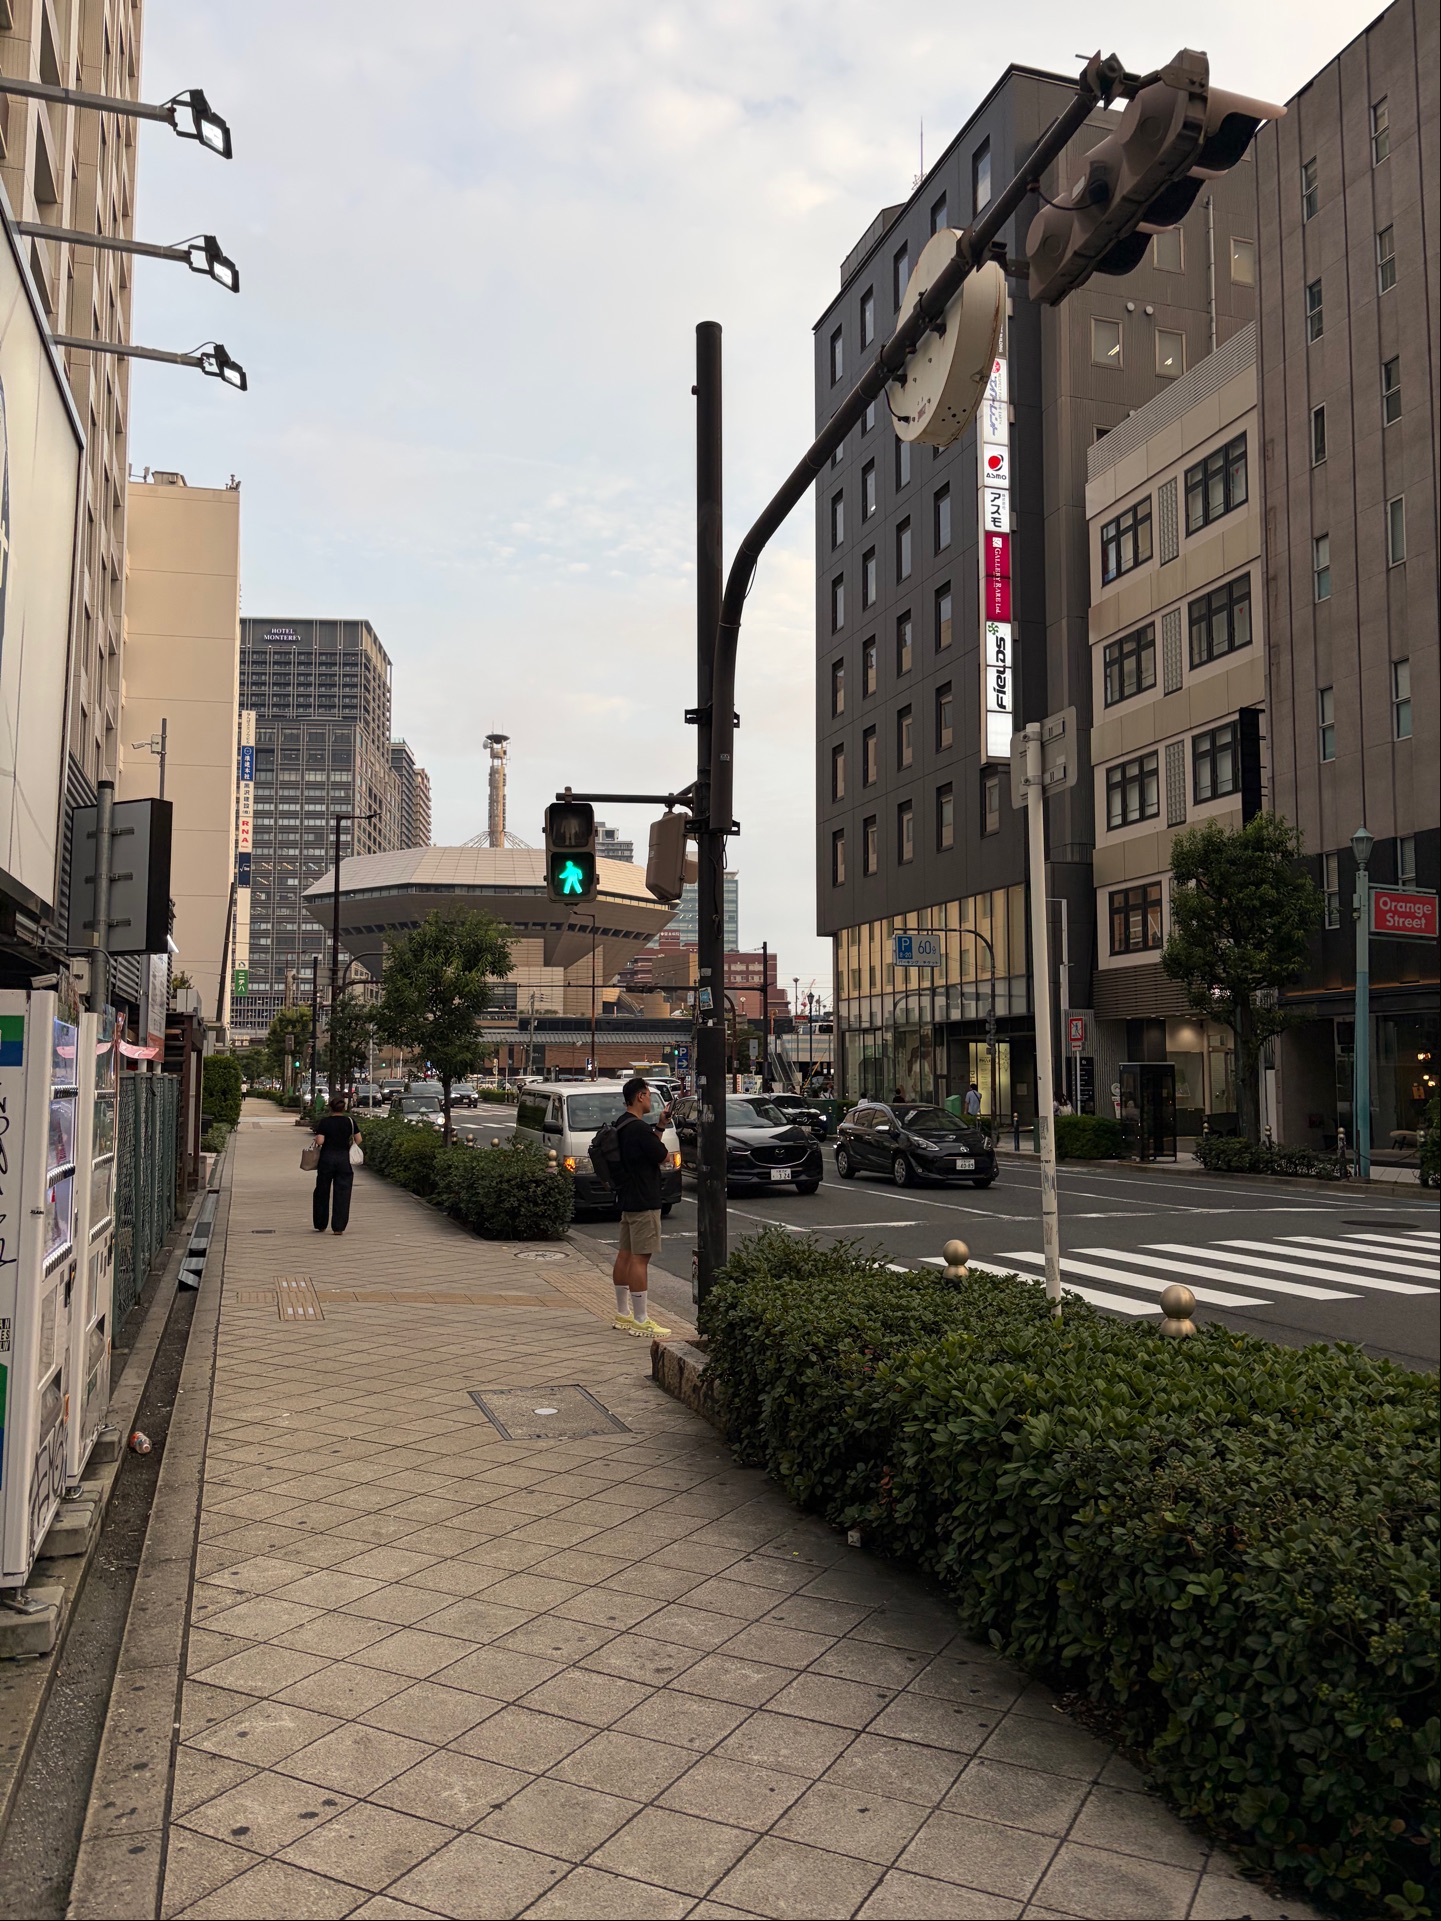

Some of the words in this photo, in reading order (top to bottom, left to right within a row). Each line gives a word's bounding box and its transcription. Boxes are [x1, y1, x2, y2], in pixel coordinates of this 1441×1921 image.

[990, 492, 1002, 528] アスモ
[994, 548, 1002, 582] GALLERY
[241, 820, 249, 843] RNA
[1379, 896, 1432, 917] Orange
[1386, 912, 1426, 928] Street
[901, 938, 910, 951] P
[679, 1047, 687, 1056] P
